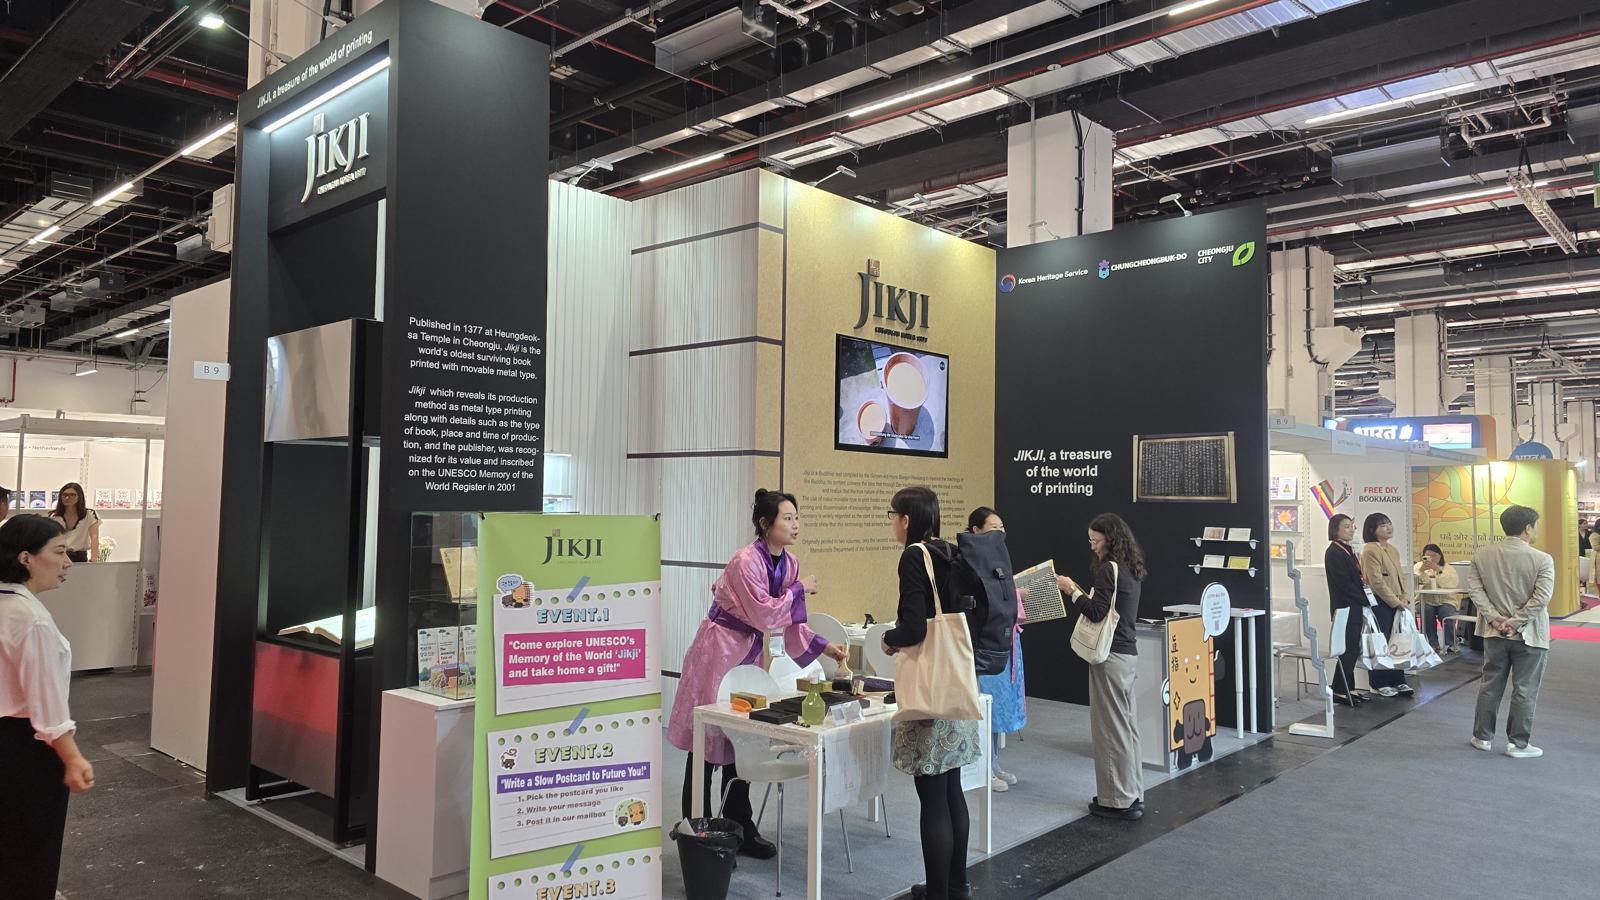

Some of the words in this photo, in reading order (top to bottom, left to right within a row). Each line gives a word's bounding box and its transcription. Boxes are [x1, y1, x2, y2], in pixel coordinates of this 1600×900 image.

[273, 91, 276, 99] a
[277, 75, 300, 97] treasure
[301, 68, 308, 81] of
[309, 63, 318, 77] the
[320, 50, 337, 70] world
[338, 46, 345, 59] of
[346, 31, 372, 57] printing
[301, 112, 370, 203] JIKJI
[1198, 245, 1234, 257] CHEONGJU
[1111, 253, 1187, 271] CHUNGCHEONGBUK-DO
[1198, 256, 1213, 264] CITY
[1037, 273, 1063, 282] Heritage
[1065, 269, 1088, 277] Service
[854, 272, 931, 330] JIKJI
[409, 317, 451, 331] Published
[453, 323, 460, 332] in
[464, 325, 482, 334] 1377
[485, 328, 492, 336] at
[408, 332, 418, 340] sa
[421, 332, 450, 345] Temple
[463, 338, 502, 351] Cheongju,
[505, 344, 519, 354] Jikji
[521, 345, 527, 353] is
[530, 346, 541, 355] the
[418, 347, 448, 357] world's
[450, 350, 474, 360] oldest
[477, 353, 510, 366] surviving
[513, 356, 531, 366] book
[410, 359, 439, 369] printed
[442, 362, 458, 371] with
[461, 364, 494, 375] movable
[497, 368, 517, 377] metal
[519, 371, 537, 380] type.
[409, 386, 425, 396] Jikji
[430, 388, 453, 397] which
[456, 391, 485, 400] reveals
[488, 393, 496, 401] its
[499, 393, 537, 404] production
[415, 401, 446, 410] method
[461, 404, 483, 412] metal
[485, 407, 501, 416] type
[504, 408, 532, 418] printing
[404, 414, 428, 423] along
[430, 415, 447, 423] with
[450, 416, 476, 425] details
[478, 418, 496, 427] such
[510, 420, 522, 428] the
[524, 422, 540, 430] type
[404, 427, 413, 435] of
[415, 427, 438, 438] book,
[441, 430, 463, 439] place
[465, 431, 480, 439] and
[482, 431, 499, 440] time
[501, 432, 510, 440] of
[511, 433, 539, 442] produc-
[403, 440, 422, 450] tion,
[424, 441, 440, 450] and
[443, 442, 456, 451] the
[458, 443, 496, 453] publisher,
[515, 447, 539, 456] recog-
[1014, 449, 1045, 462] JIKJI,
[1049, 451, 1056, 460] a
[1060, 449, 1112, 460] treasure
[409, 454, 432, 463] nized
[434, 455, 446, 464] for
[448, 456, 458, 464] its
[460, 456, 481, 465] value
[483, 457, 498, 466] and
[500, 458, 534, 467] inscribed
[422, 468, 435, 477] the
[438, 469, 477, 478] UNESCO
[479, 470, 510, 480] Memory
[512, 470, 520, 478] of
[521, 470, 533, 479] the
[1026, 466, 1038, 477] of
[1041, 466, 1060, 477] the
[1063, 465, 1098, 477] world
[425, 482, 449, 490] World
[452, 482, 486, 493] Register
[488, 483, 495, 491] in
[497, 484, 516, 492] 2001
[1030, 482, 1042, 493] of
[1045, 482, 1093, 496] printing
[1364, 486, 1383, 494] FREE
[542, 536, 603, 565] JIKJI
[537, 608, 609, 624] EVENT.1
[546, 638, 582, 649] explore
[585, 636, 635, 646] UNESCO's
[509, 654, 550, 664] Memory
[553, 653, 562, 662] of
[565, 652, 581, 661] the
[585, 650, 612, 660] World
[508, 668, 528, 678] and
[532, 666, 555, 676] take
[557, 664, 586, 675] home
[535, 742, 614, 764] EVENT.2
[527, 778, 532, 787] a
[535, 775, 553, 786] Slow
[555, 772, 590, 784] Postcard
[592, 771, 600, 780] to
[602, 768, 626, 779] Future
[560, 789, 593, 798] postcard
[595, 788, 608, 796] you
[526, 805, 546, 814] Write
[548, 804, 565, 812] your
[567, 800, 600, 809] message
[526, 818, 543, 826] Post
[577, 811, 606, 819] mailbox
[536, 879, 616, 900] EVENT.3
